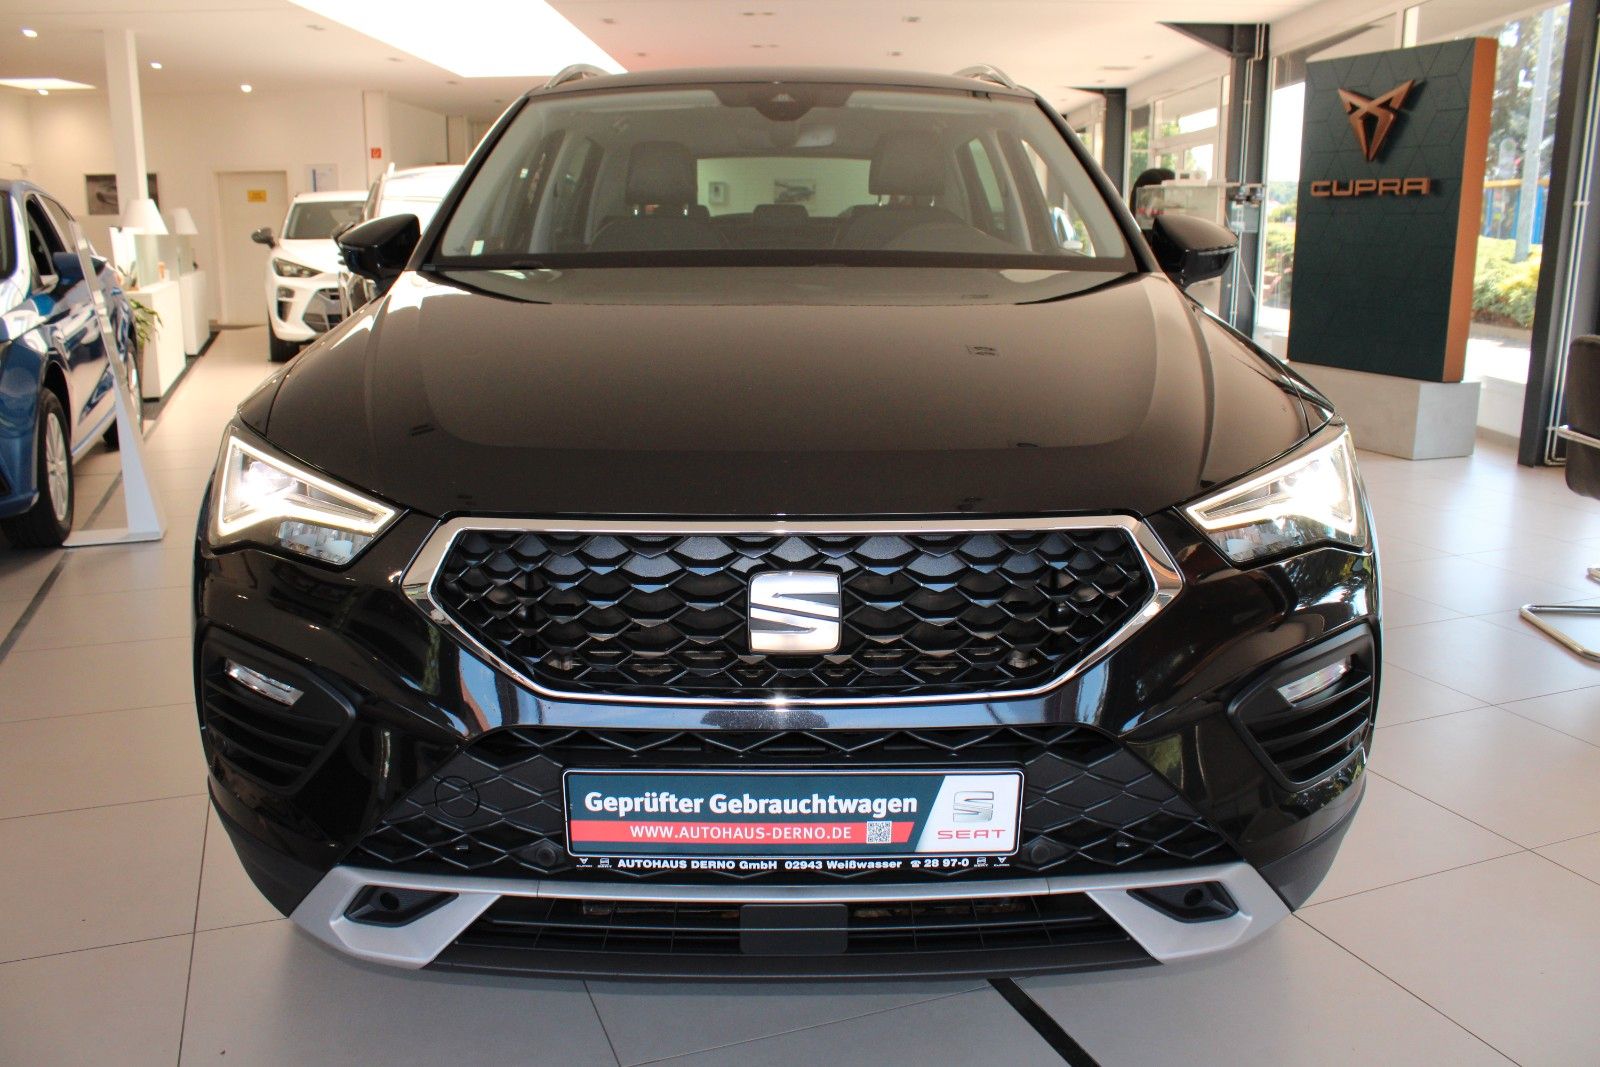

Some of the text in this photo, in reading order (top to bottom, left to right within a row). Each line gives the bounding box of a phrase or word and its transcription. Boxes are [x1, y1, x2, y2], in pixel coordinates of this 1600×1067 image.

[1310, 177, 1430, 197] CUPRA
[584, 791, 917, 818] Geprüfter Gebrauchtwagen
[629, 825, 852, 839] WWW.AUTOHAUS-DERNO.DE
[937, 829, 1005, 839] SEAT
[617, 859, 688, 869] AUTOHAUS
[691, 860, 735, 870] DERNO
[739, 861, 777, 870] GmbH
[784, 860, 823, 869] 02943
[826, 860, 902, 869] Weißwasser
[923, 858, 940, 868] 28
[942, 858, 970, 867] 97-0
